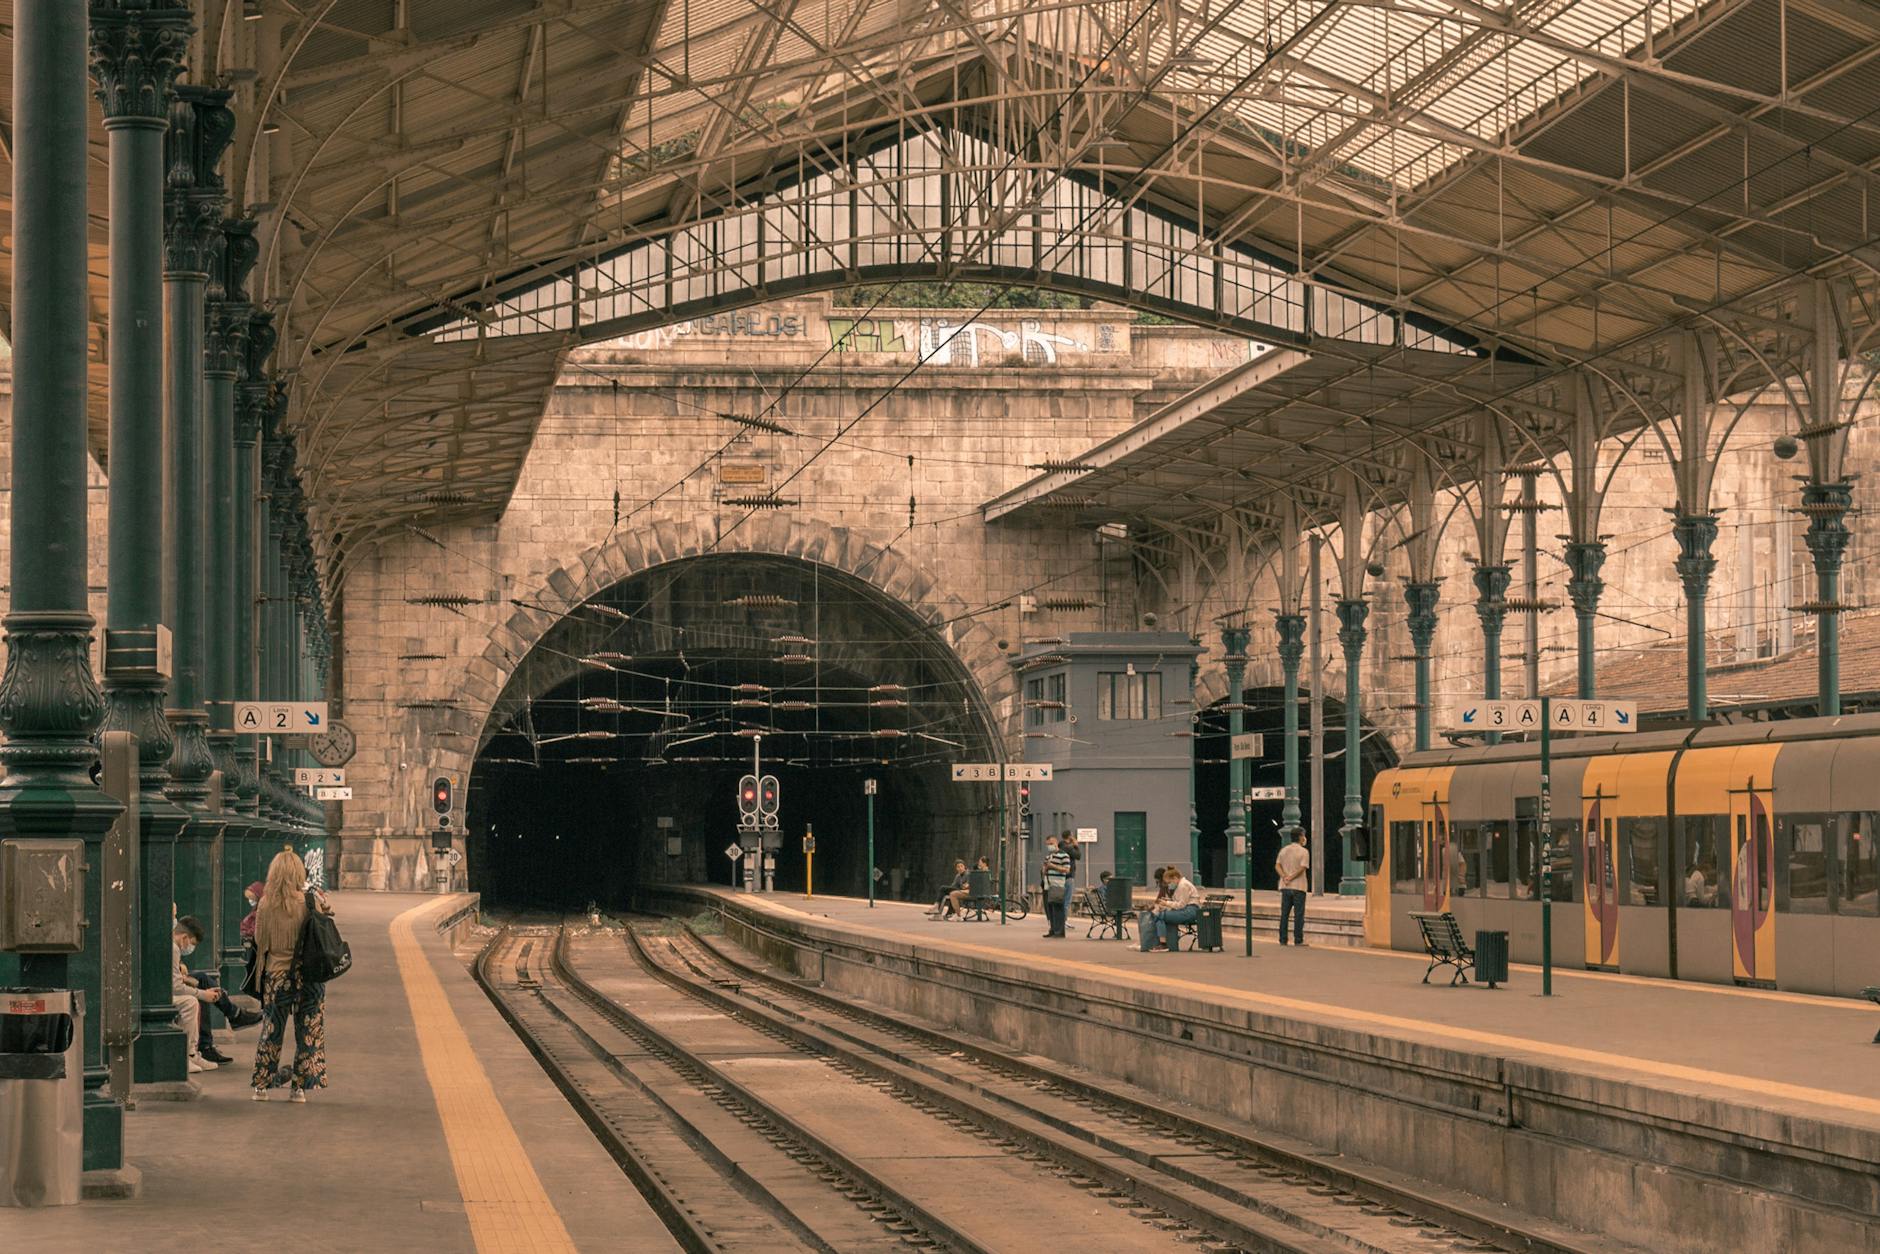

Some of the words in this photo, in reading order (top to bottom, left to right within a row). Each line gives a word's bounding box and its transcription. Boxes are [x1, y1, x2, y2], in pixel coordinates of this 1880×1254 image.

[243, 711, 257, 725] A
[276, 713, 287, 728] 2
[1494, 710, 1503, 725] 3
[1521, 709, 1534, 723] A
[1558, 708, 1570, 722] A
[1587, 710, 1598, 725] 4
[301, 773, 308, 781] B
[318, 774, 324, 783] 2
[974, 770, 980, 778] 3
